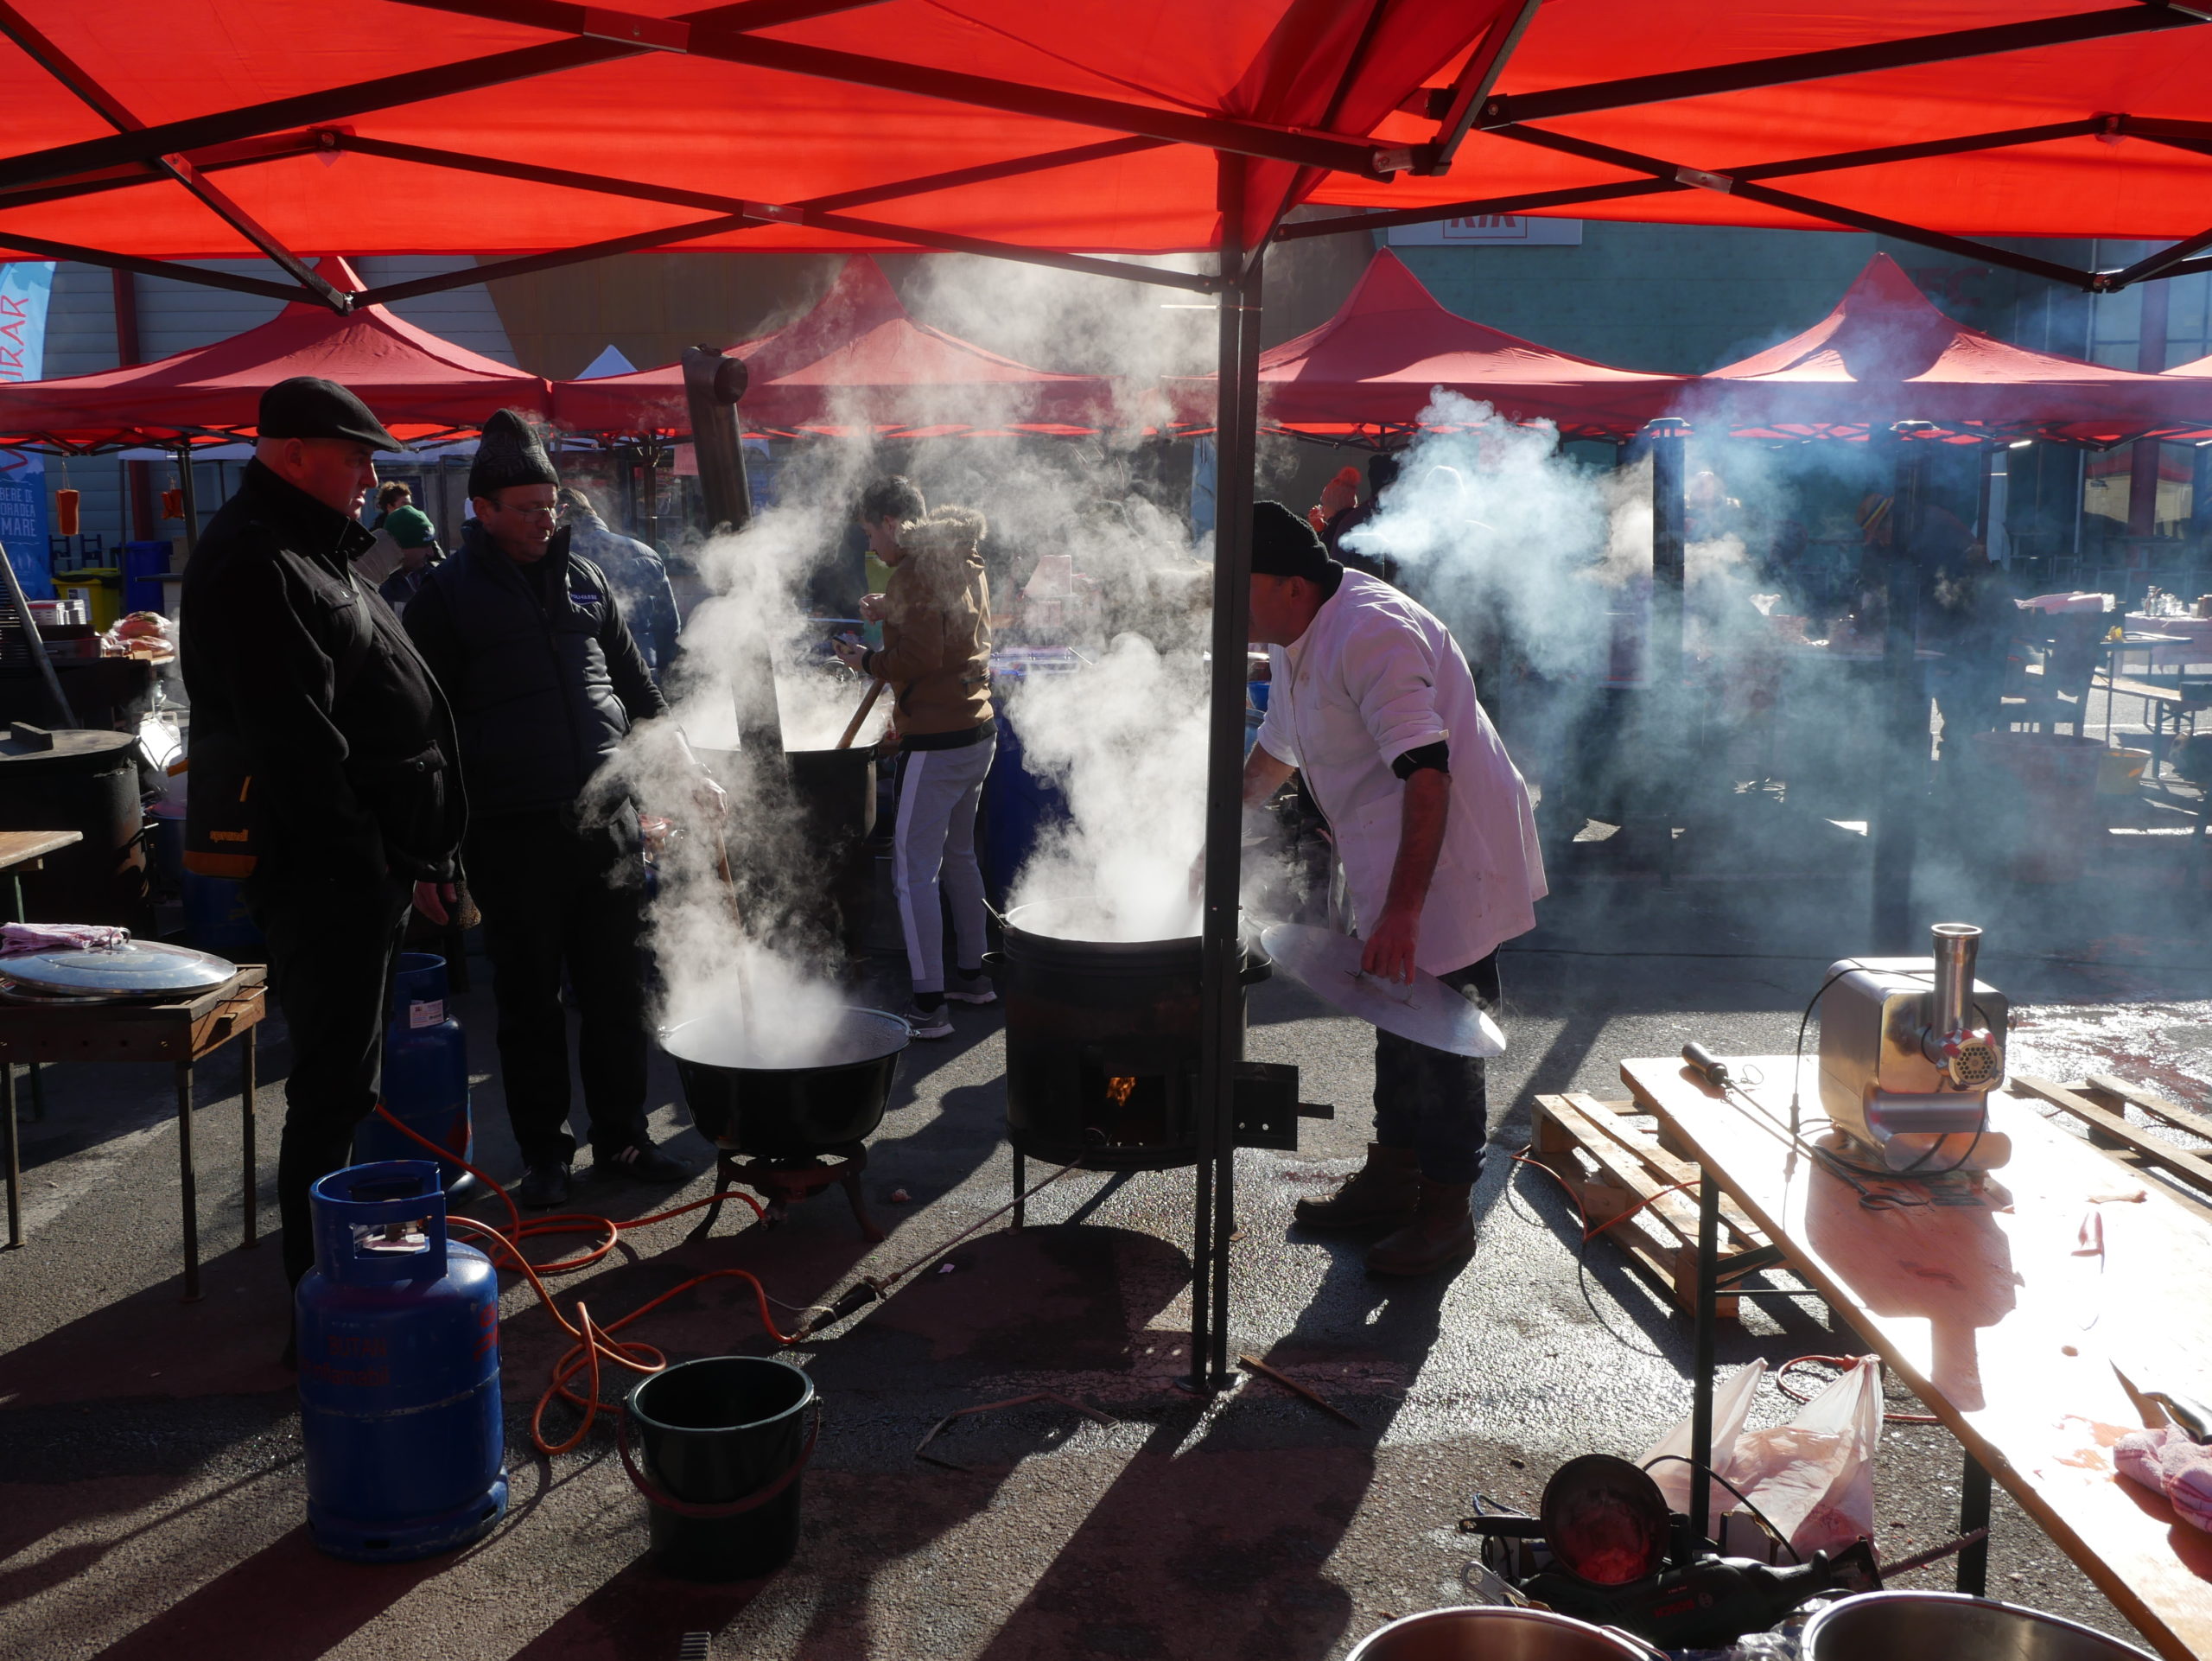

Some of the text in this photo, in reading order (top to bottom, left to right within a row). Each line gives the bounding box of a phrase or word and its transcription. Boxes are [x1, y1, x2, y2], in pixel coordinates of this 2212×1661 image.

[24, 489, 34, 503] DE
[1, 518, 37, 537] MARE
[327, 1335, 388, 1357] BUTAN
